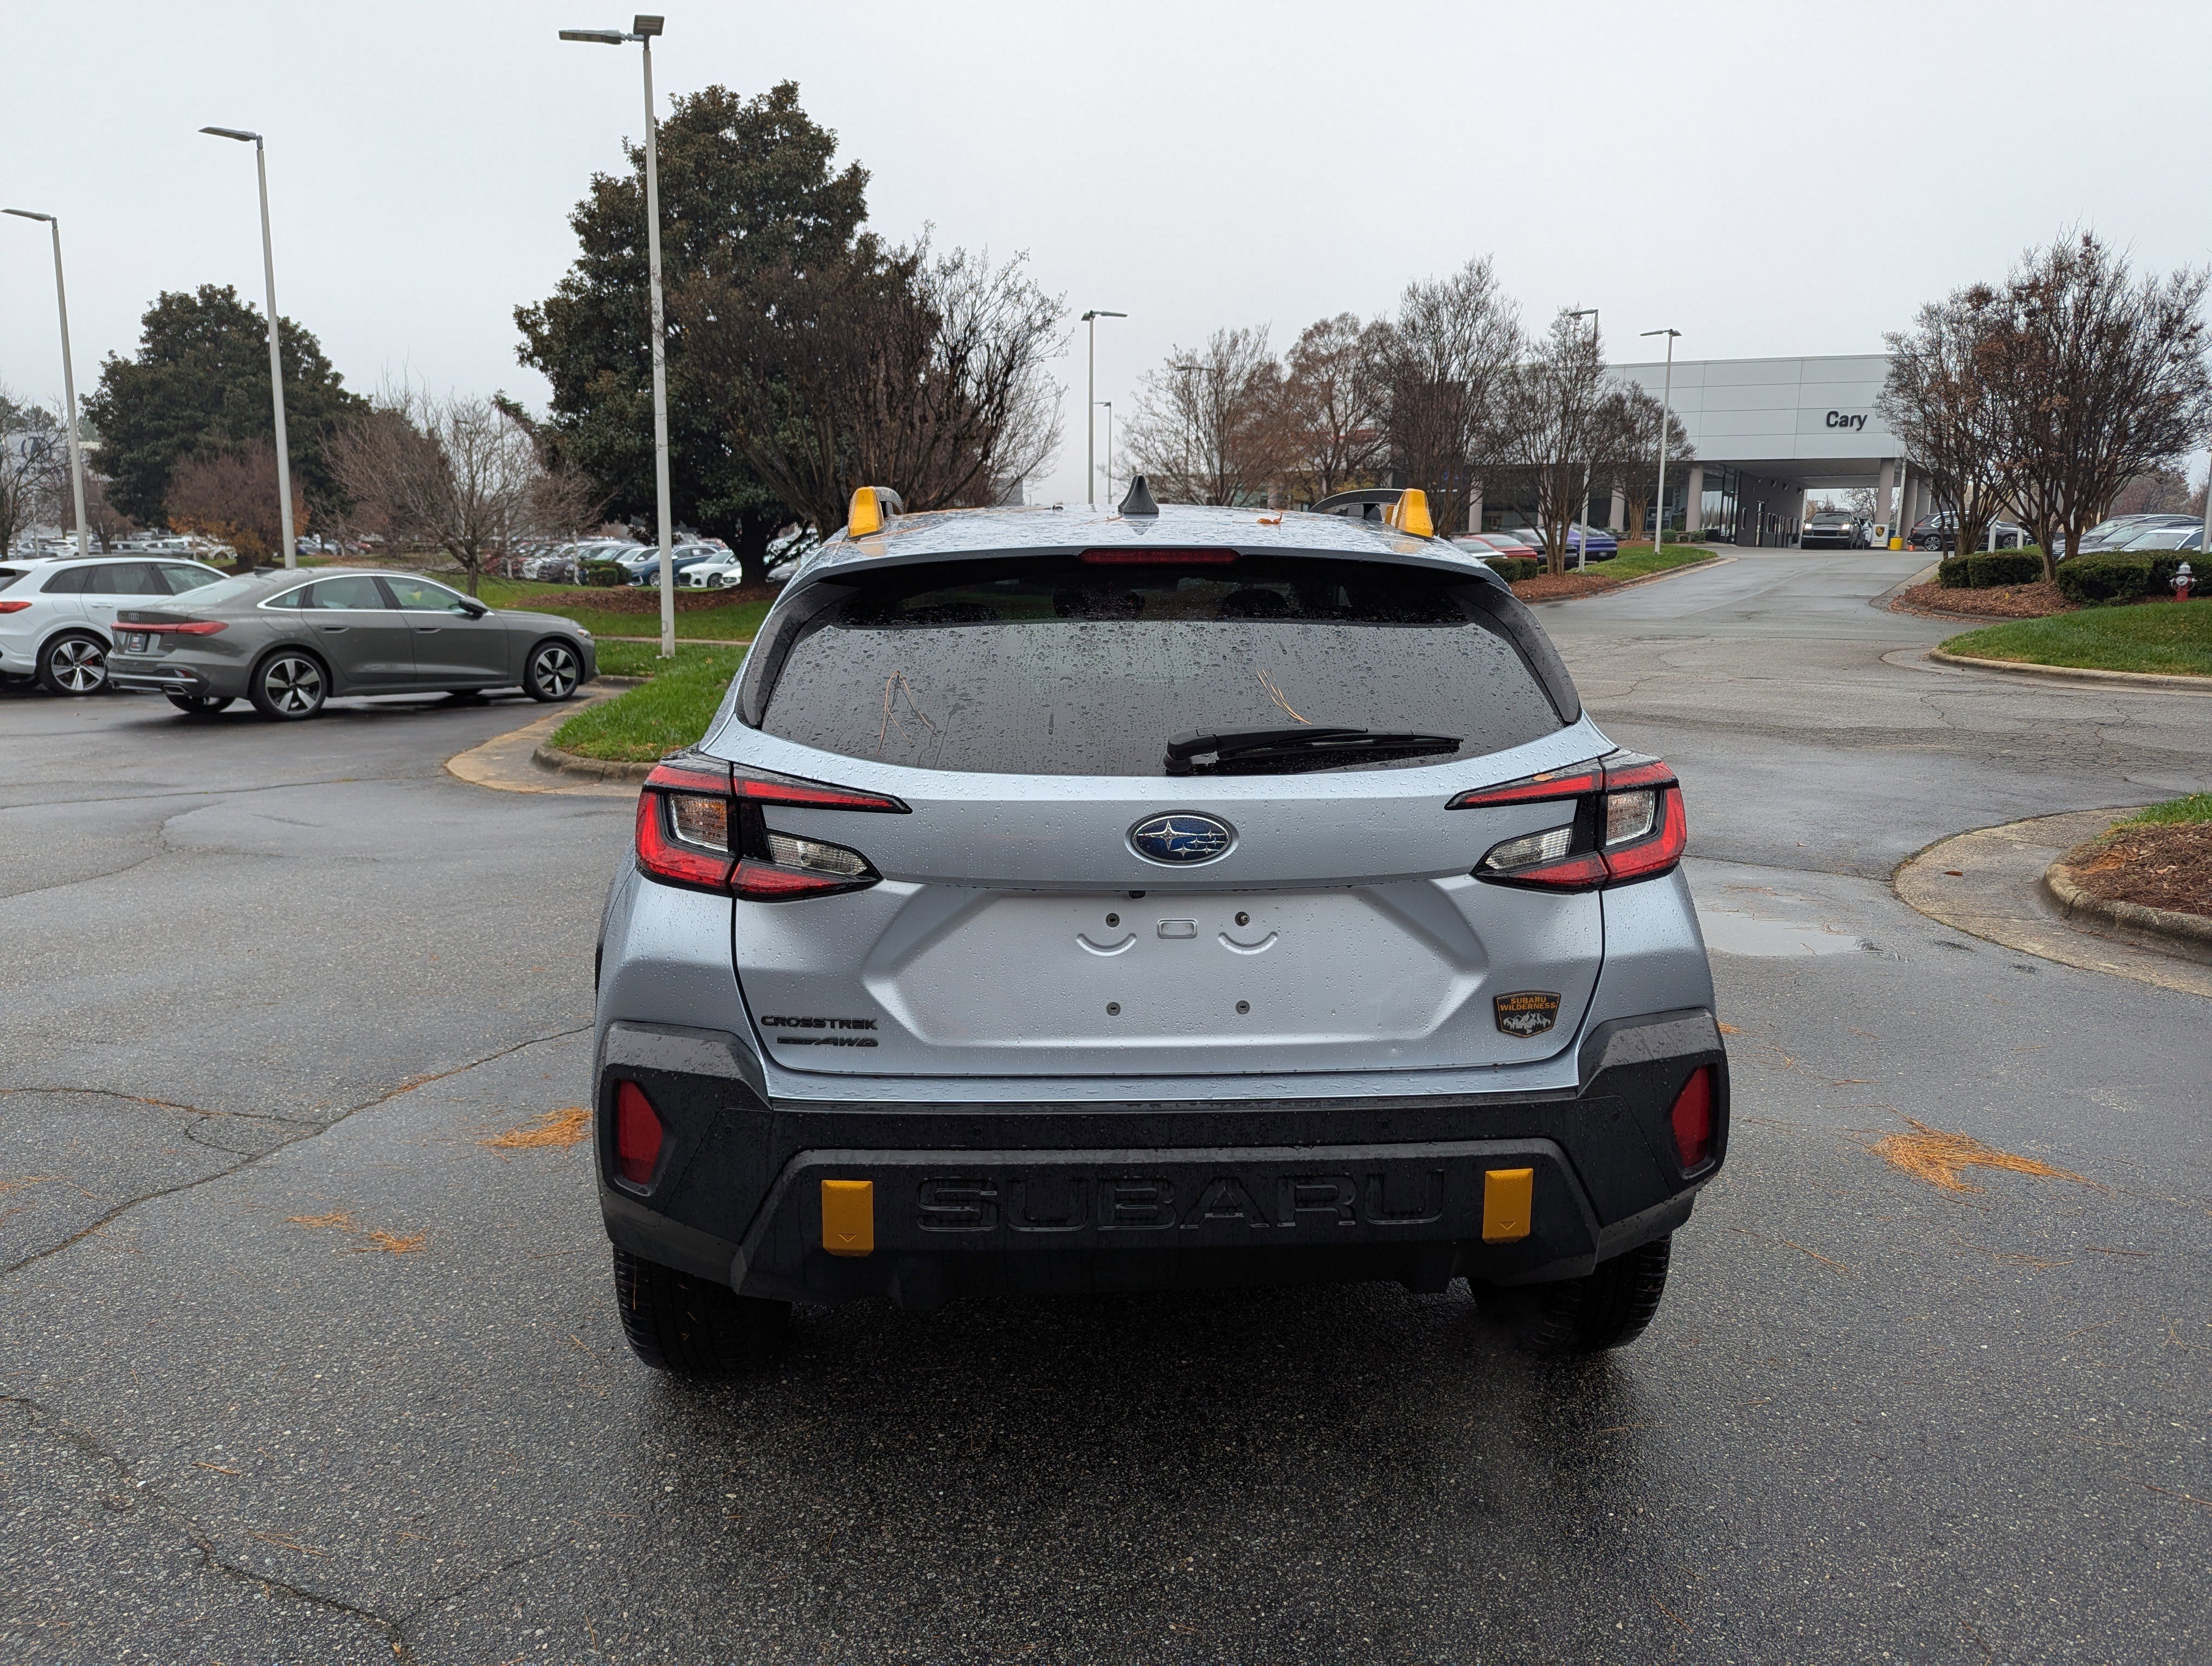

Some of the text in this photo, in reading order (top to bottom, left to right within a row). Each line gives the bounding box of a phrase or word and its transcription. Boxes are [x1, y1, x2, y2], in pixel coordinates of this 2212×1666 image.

[1826, 411, 1868, 431] Cary
[1500, 1002, 1557, 1011] WILDERNESS
[761, 1015, 878, 1030] CROSSTREK
[814, 1036, 879, 1047] AWD
[916, 1170, 1444, 1232] SUBARU
